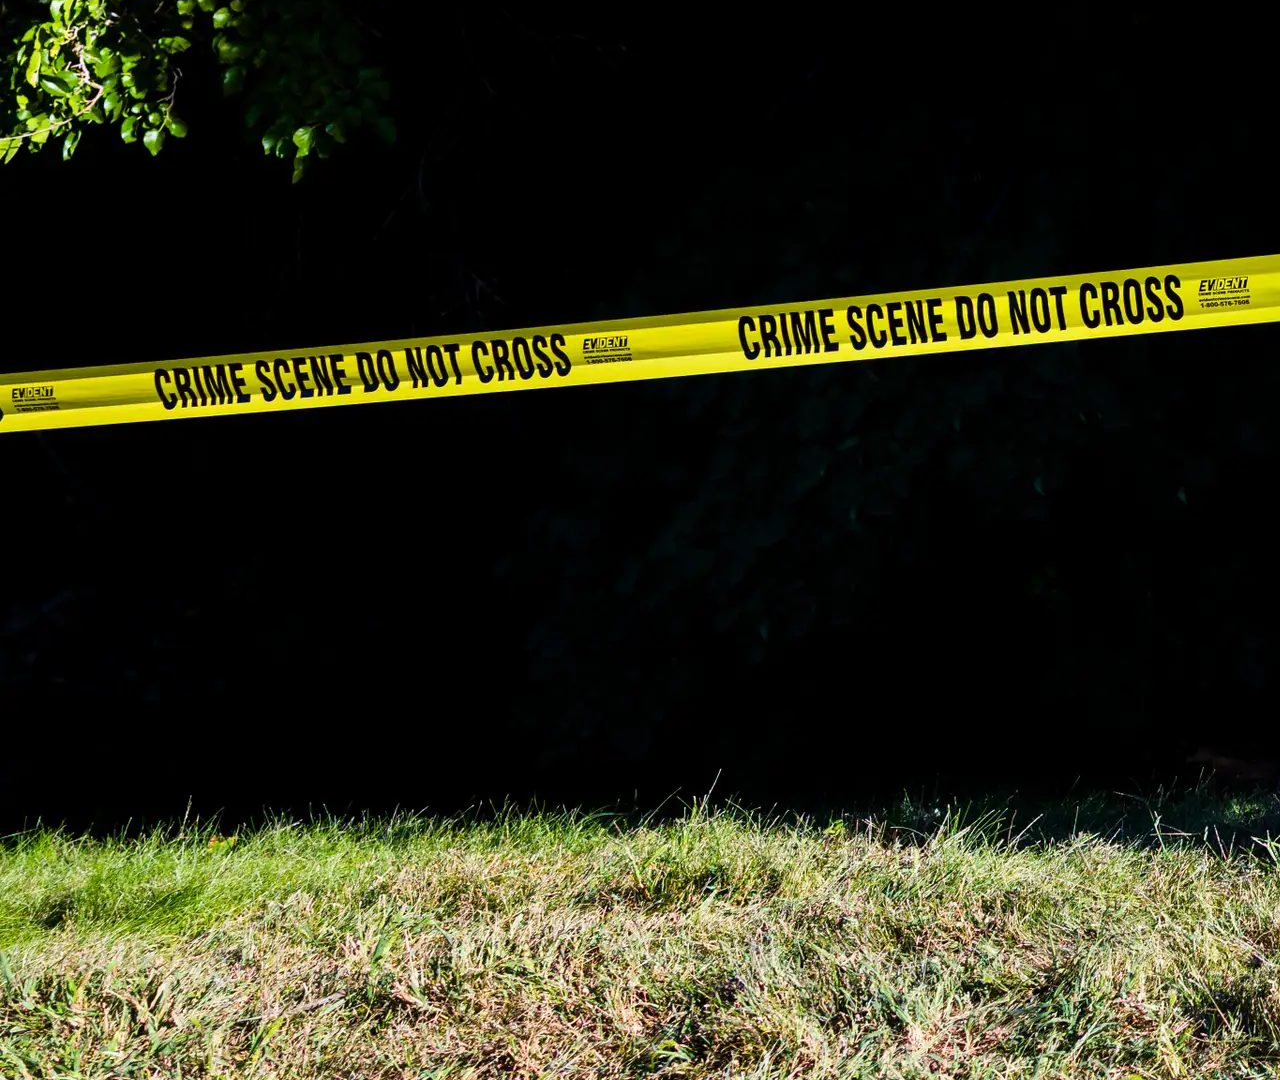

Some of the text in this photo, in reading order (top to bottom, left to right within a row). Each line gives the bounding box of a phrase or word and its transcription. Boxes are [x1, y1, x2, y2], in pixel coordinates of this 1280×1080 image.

[1199, 276, 1249, 292] EVIDENT
[738, 274, 1184, 361] CRIME SCENE DO NOT CROSS
[583, 336, 628, 350] EVIDENT
[153, 332, 572, 411] CRIME SCENE DO NOT CROSS
[12, 386, 54, 399] EVIDENT
